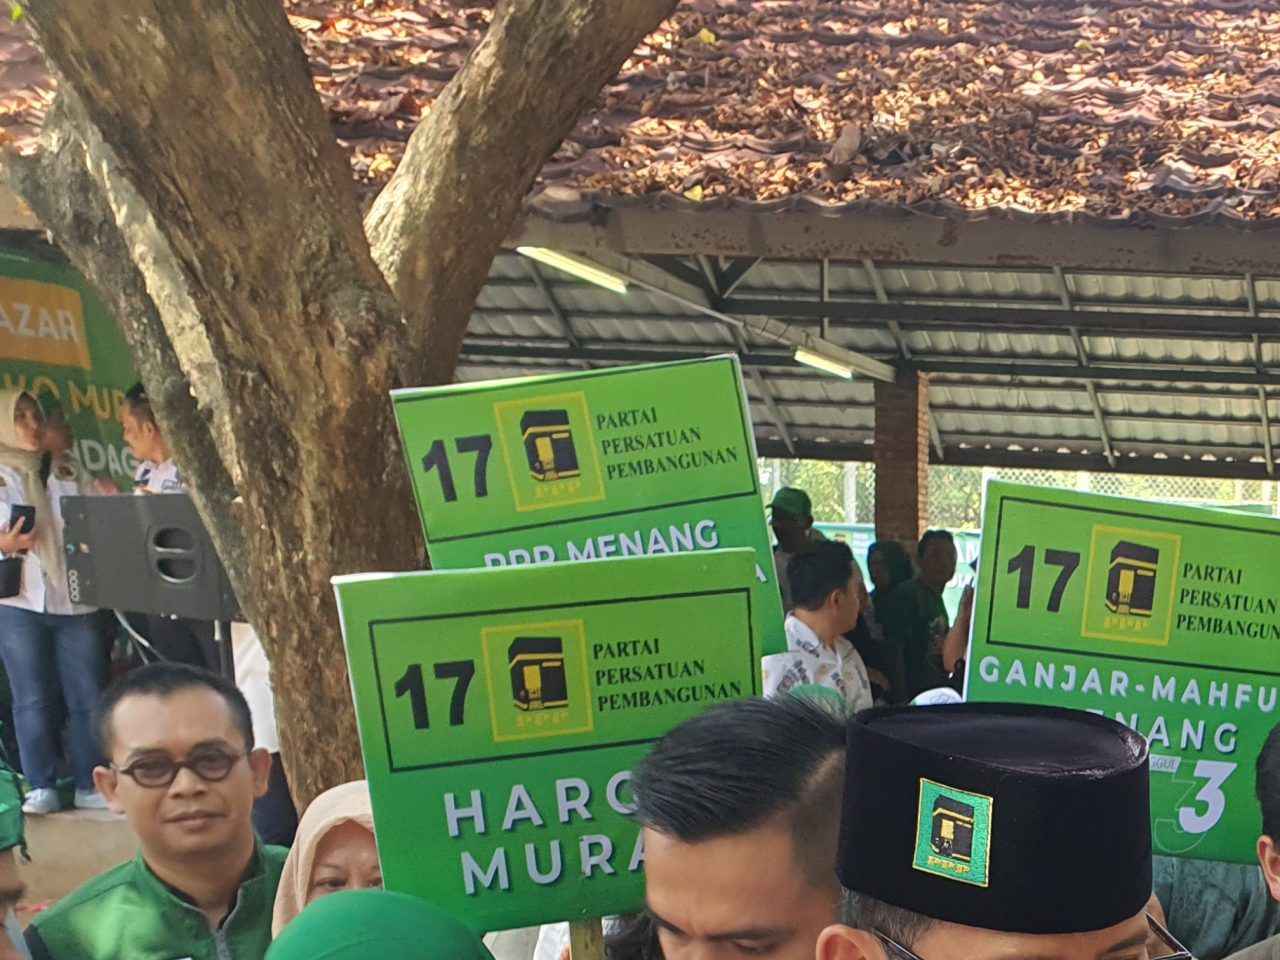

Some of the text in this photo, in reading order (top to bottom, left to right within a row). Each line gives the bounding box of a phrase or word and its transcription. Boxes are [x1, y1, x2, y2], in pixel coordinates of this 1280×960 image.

[0, 304, 79, 343] AZAR
[596, 407, 658, 430] PARTAI
[601, 427, 702, 455] PERSATUAN
[422, 434, 493, 503] 17
[607, 446, 738, 480] PEMBANGUNAN
[567, 520, 719, 562] MENANG
[1006, 543, 1081, 613] 17
[1183, 562, 1242, 585] PARTAI
[1179, 587, 1278, 615] PERSATUAN
[593, 638, 660, 660] PARTAI
[595, 660, 705, 686] PERSATUAN
[393, 659, 475, 730] 17
[597, 681, 742, 712] PEMBANGUNAN
[444, 771, 638, 838] HARG
[1178, 759, 1238, 834] 3
